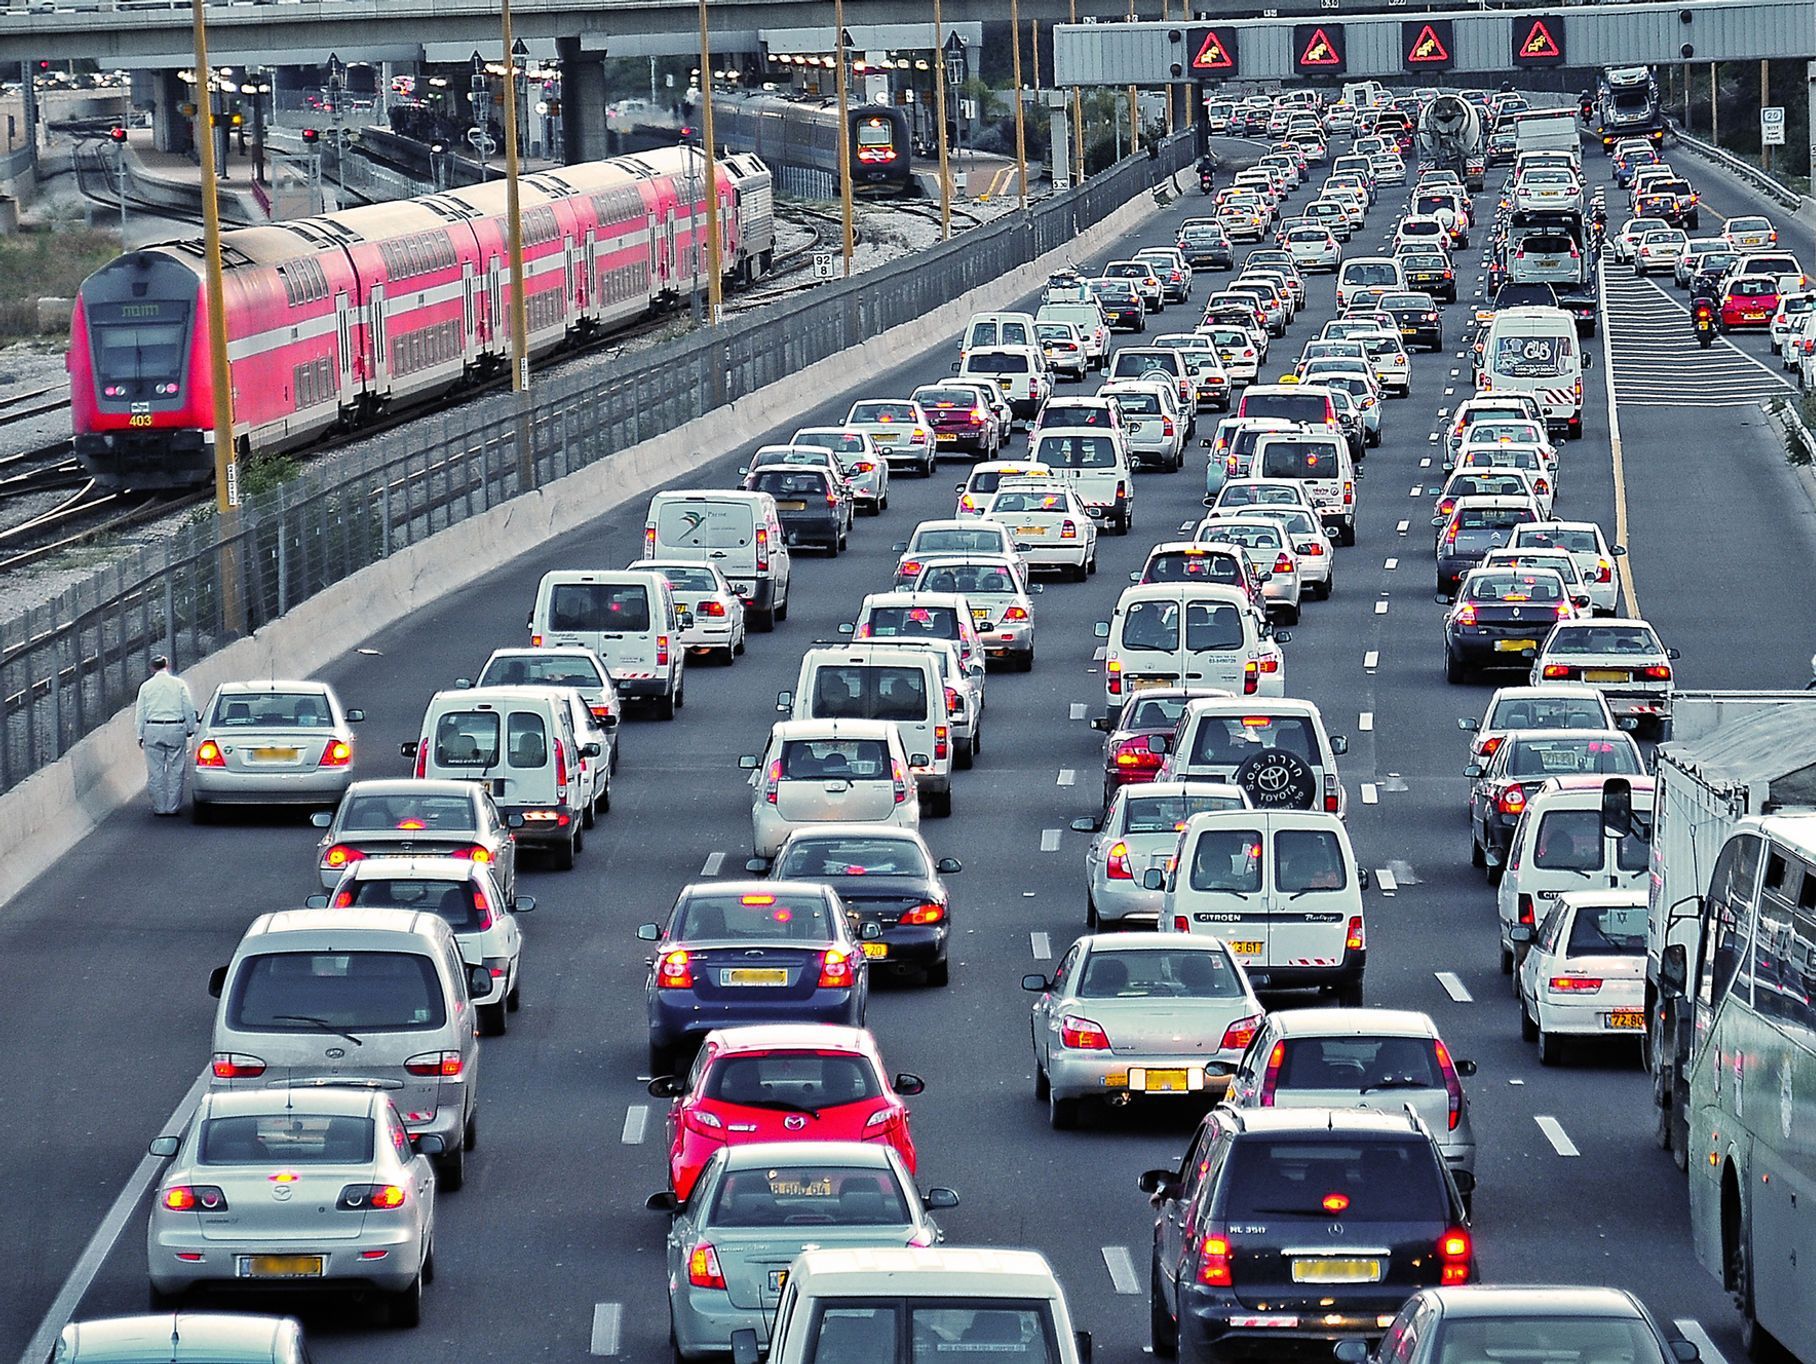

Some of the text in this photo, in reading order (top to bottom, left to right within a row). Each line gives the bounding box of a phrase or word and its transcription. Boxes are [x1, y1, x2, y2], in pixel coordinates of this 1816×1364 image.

[1766, 111, 1779, 120] 20
[816, 255, 831, 266] 92
[820, 265, 828, 276] 8
[121, 304, 160, 318] רחובות
[129, 414, 152, 427] 403
[1267, 754, 1303, 779] חדרה
[1260, 784, 1297, 802] TOYOTA
[1199, 913, 1241, 922] CITROEN
